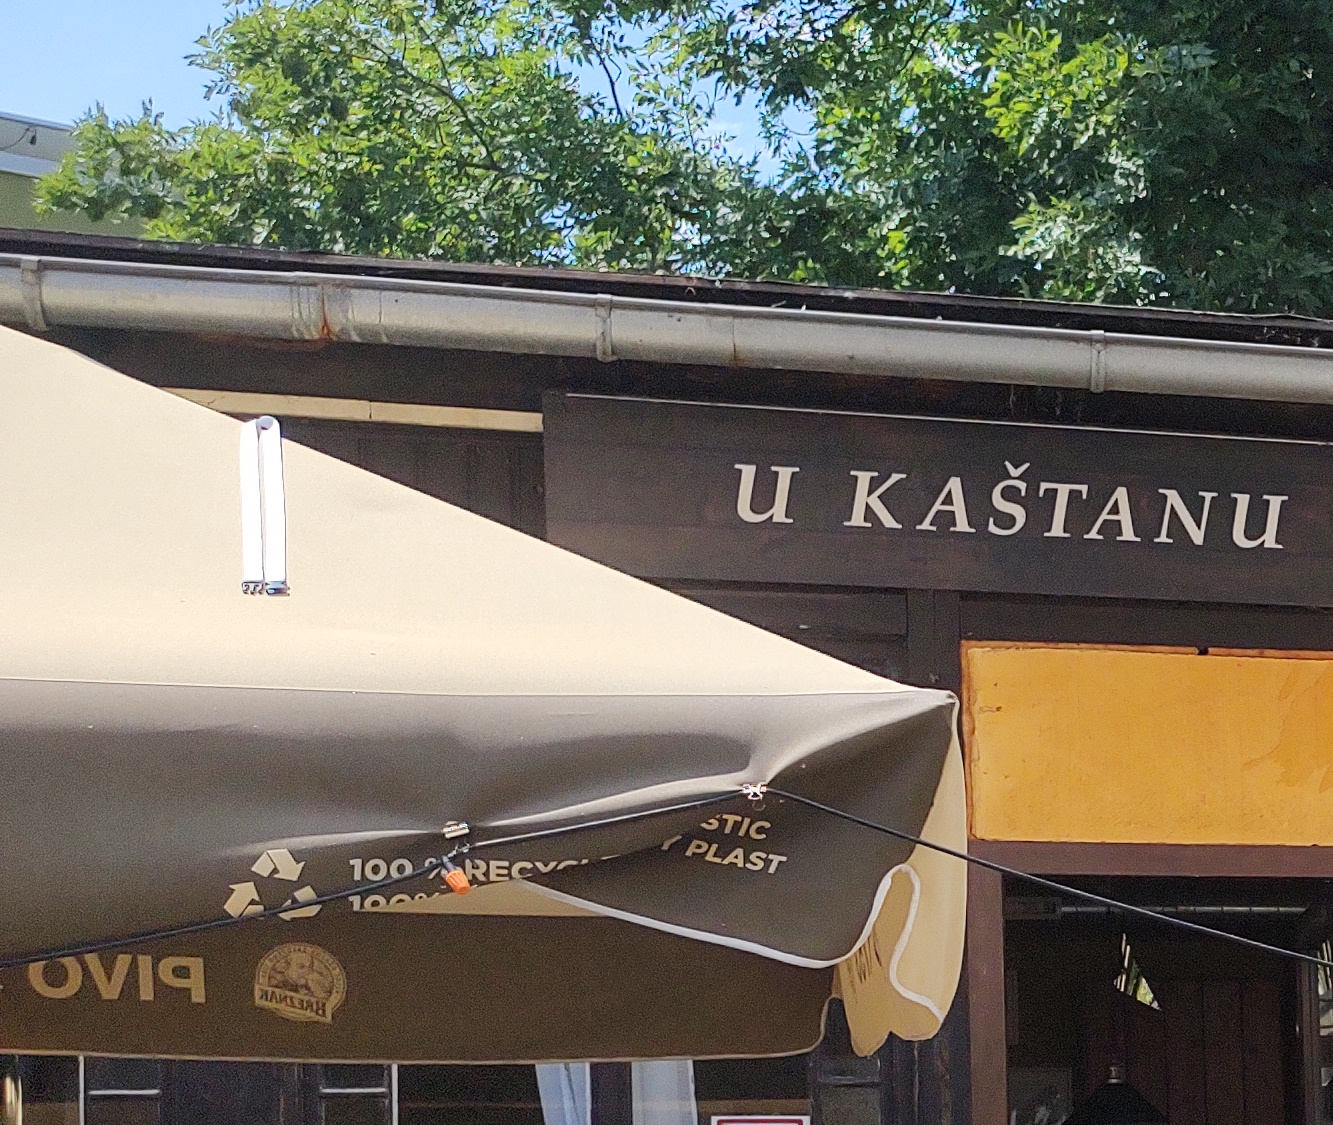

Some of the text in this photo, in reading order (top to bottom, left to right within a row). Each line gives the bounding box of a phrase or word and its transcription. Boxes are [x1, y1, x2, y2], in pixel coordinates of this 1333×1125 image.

[734, 460, 1290, 550] U KAŠTANU
[685, 838, 788, 874] PLAST
